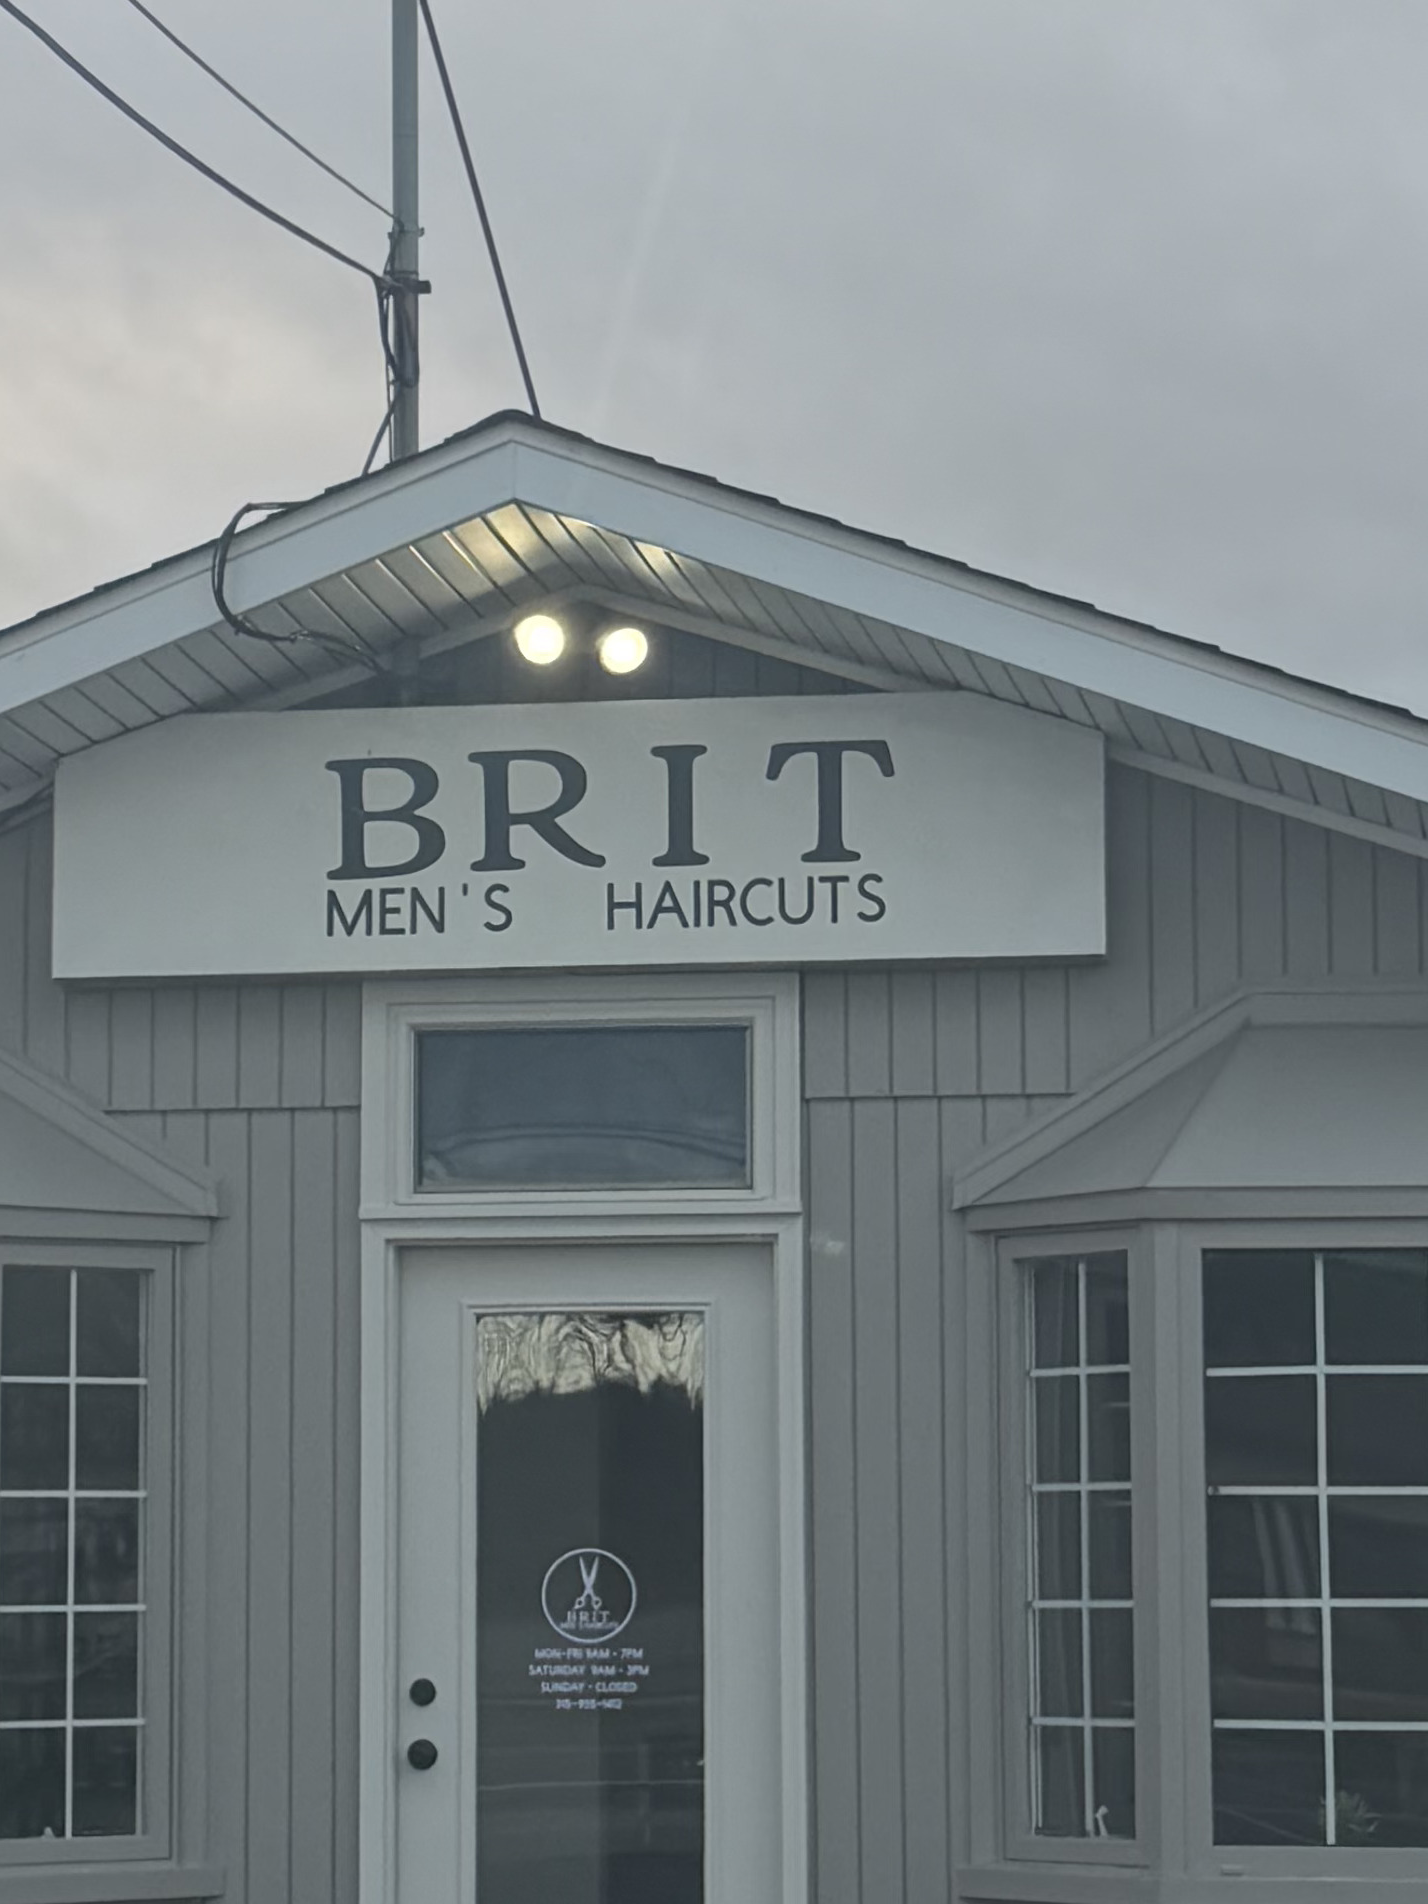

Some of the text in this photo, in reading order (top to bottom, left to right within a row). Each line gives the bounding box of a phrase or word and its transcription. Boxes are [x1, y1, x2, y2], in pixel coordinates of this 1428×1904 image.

[324, 738, 896, 881] BRIT
[325, 872, 888, 938] MEN'S HAIRCUTS
[528, 1664, 585, 1676] SATURDAY
[540, 1681, 585, 1693] SUNDAY
[594, 1681, 638, 1693] CLOSED
